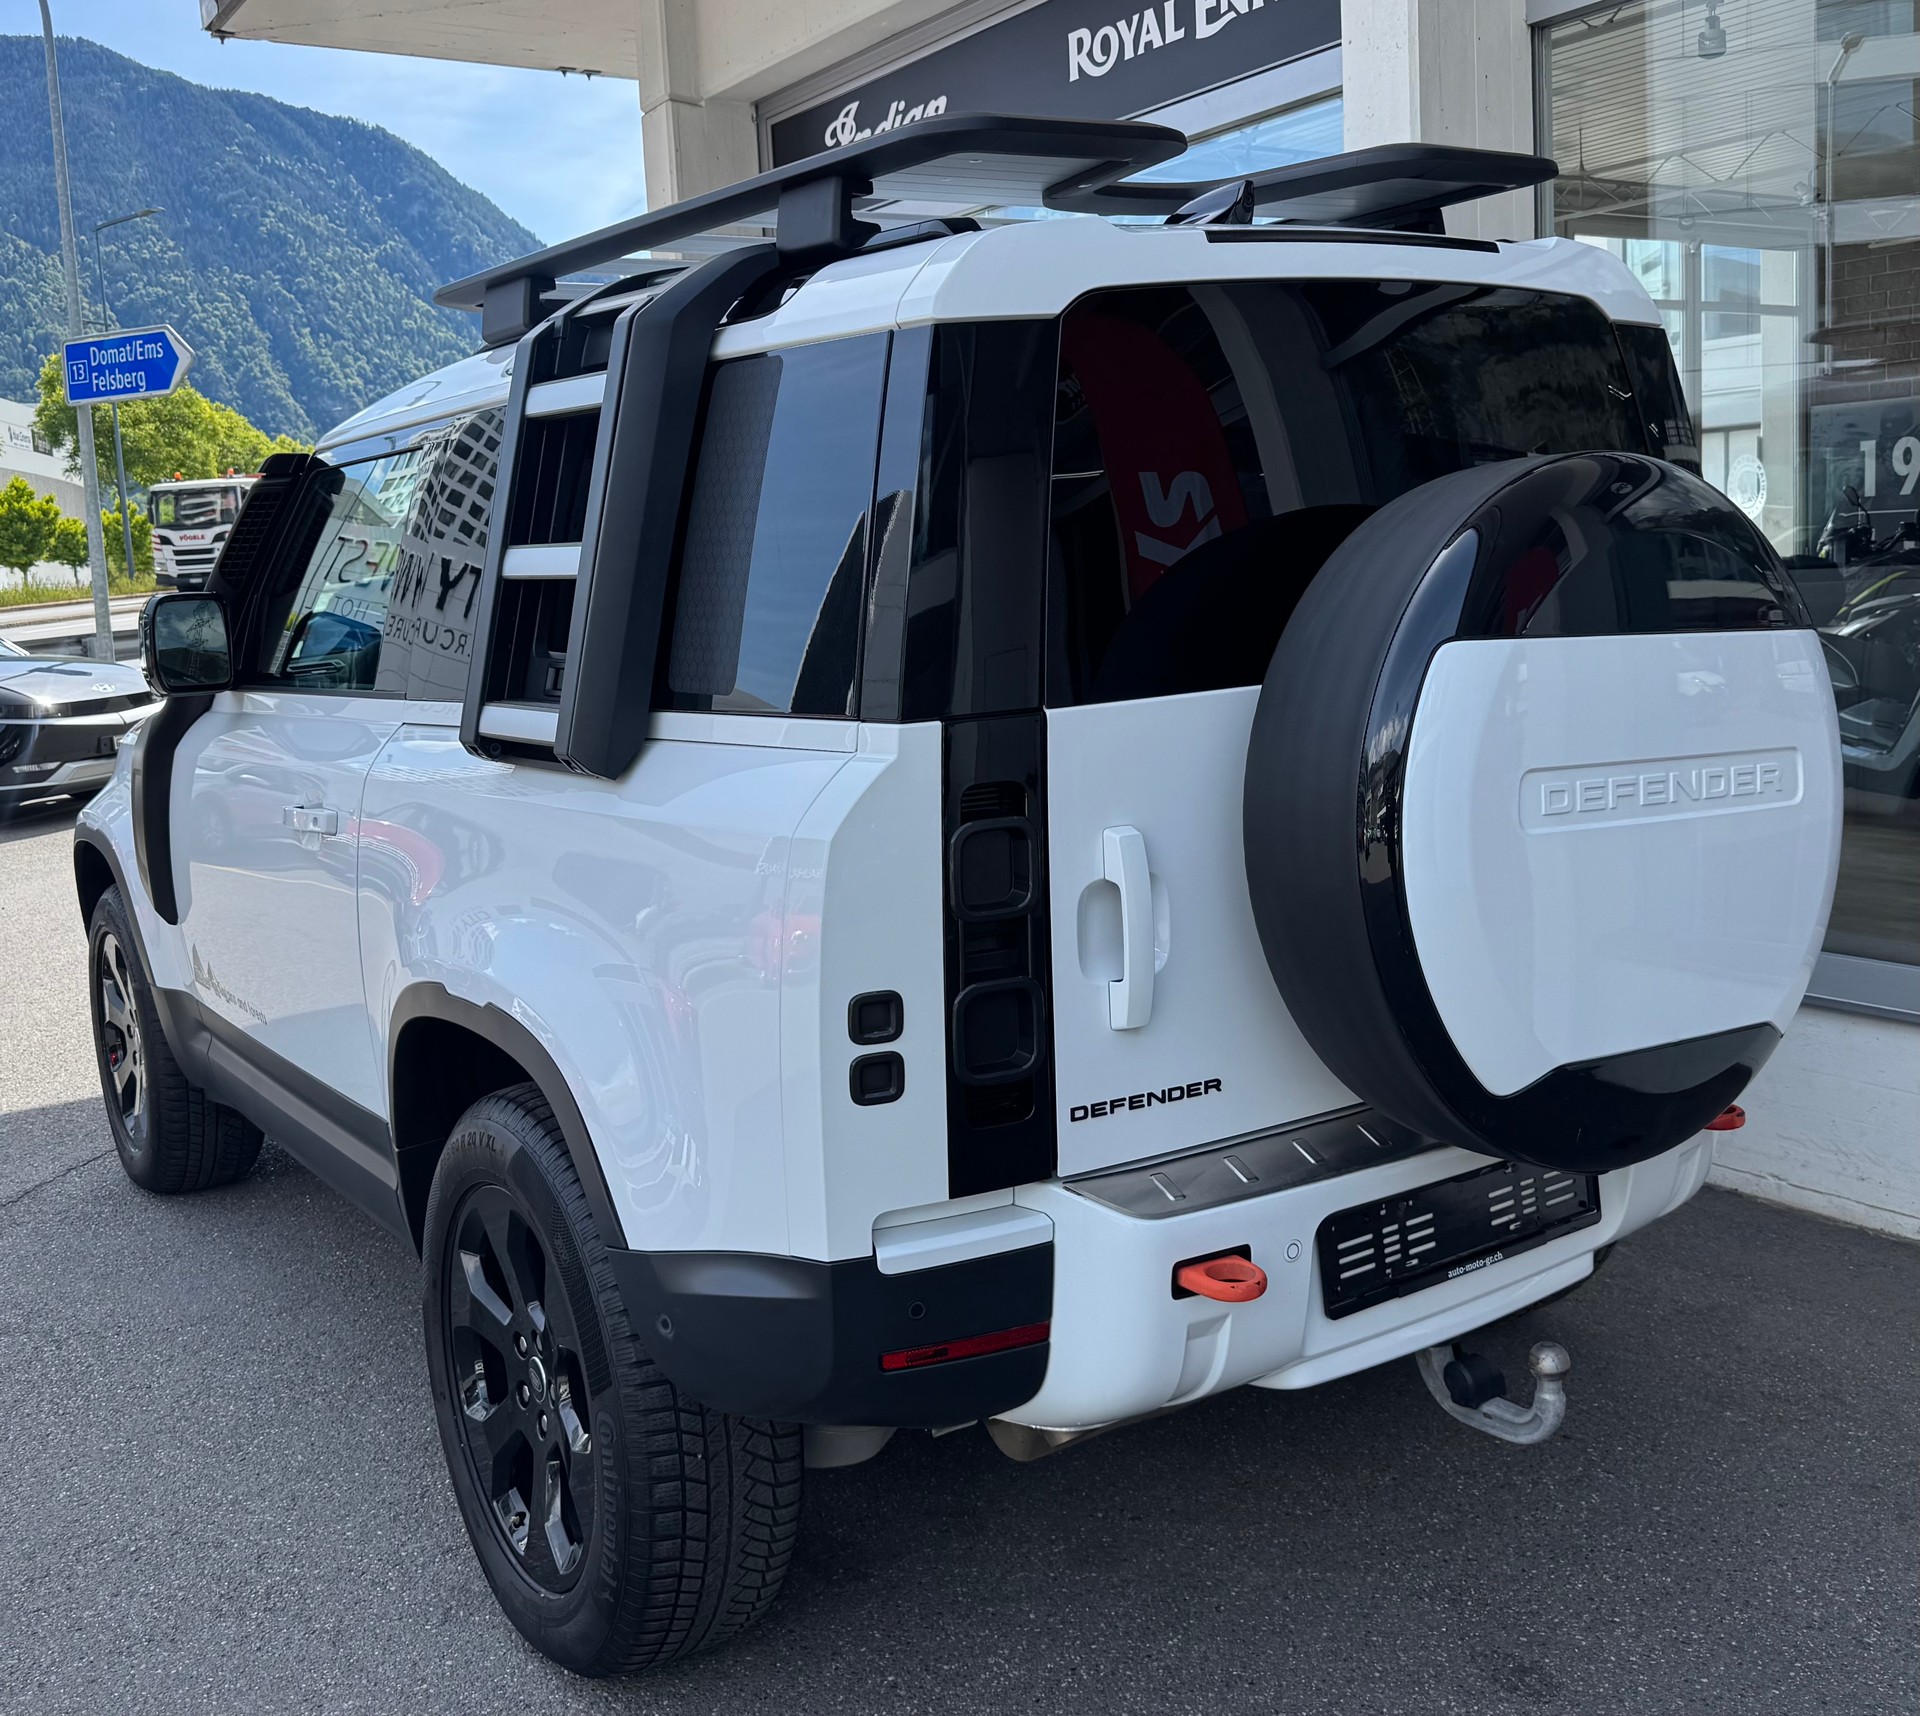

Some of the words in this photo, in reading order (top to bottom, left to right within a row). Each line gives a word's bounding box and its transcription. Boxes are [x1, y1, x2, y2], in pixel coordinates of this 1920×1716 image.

[1067, 0, 1186, 82] ROYAL
[90, 340, 164, 367] Domat/Ems
[72, 363, 86, 381] 13
[92, 367, 146, 392] Felsberg
[1540, 762, 1783, 816] DEFENDER
[1070, 1078, 1222, 1122] DEFENDER
[1447, 1251, 1503, 1279] auto-moto-gr.ch
[597, 1411, 624, 1588] Continental
